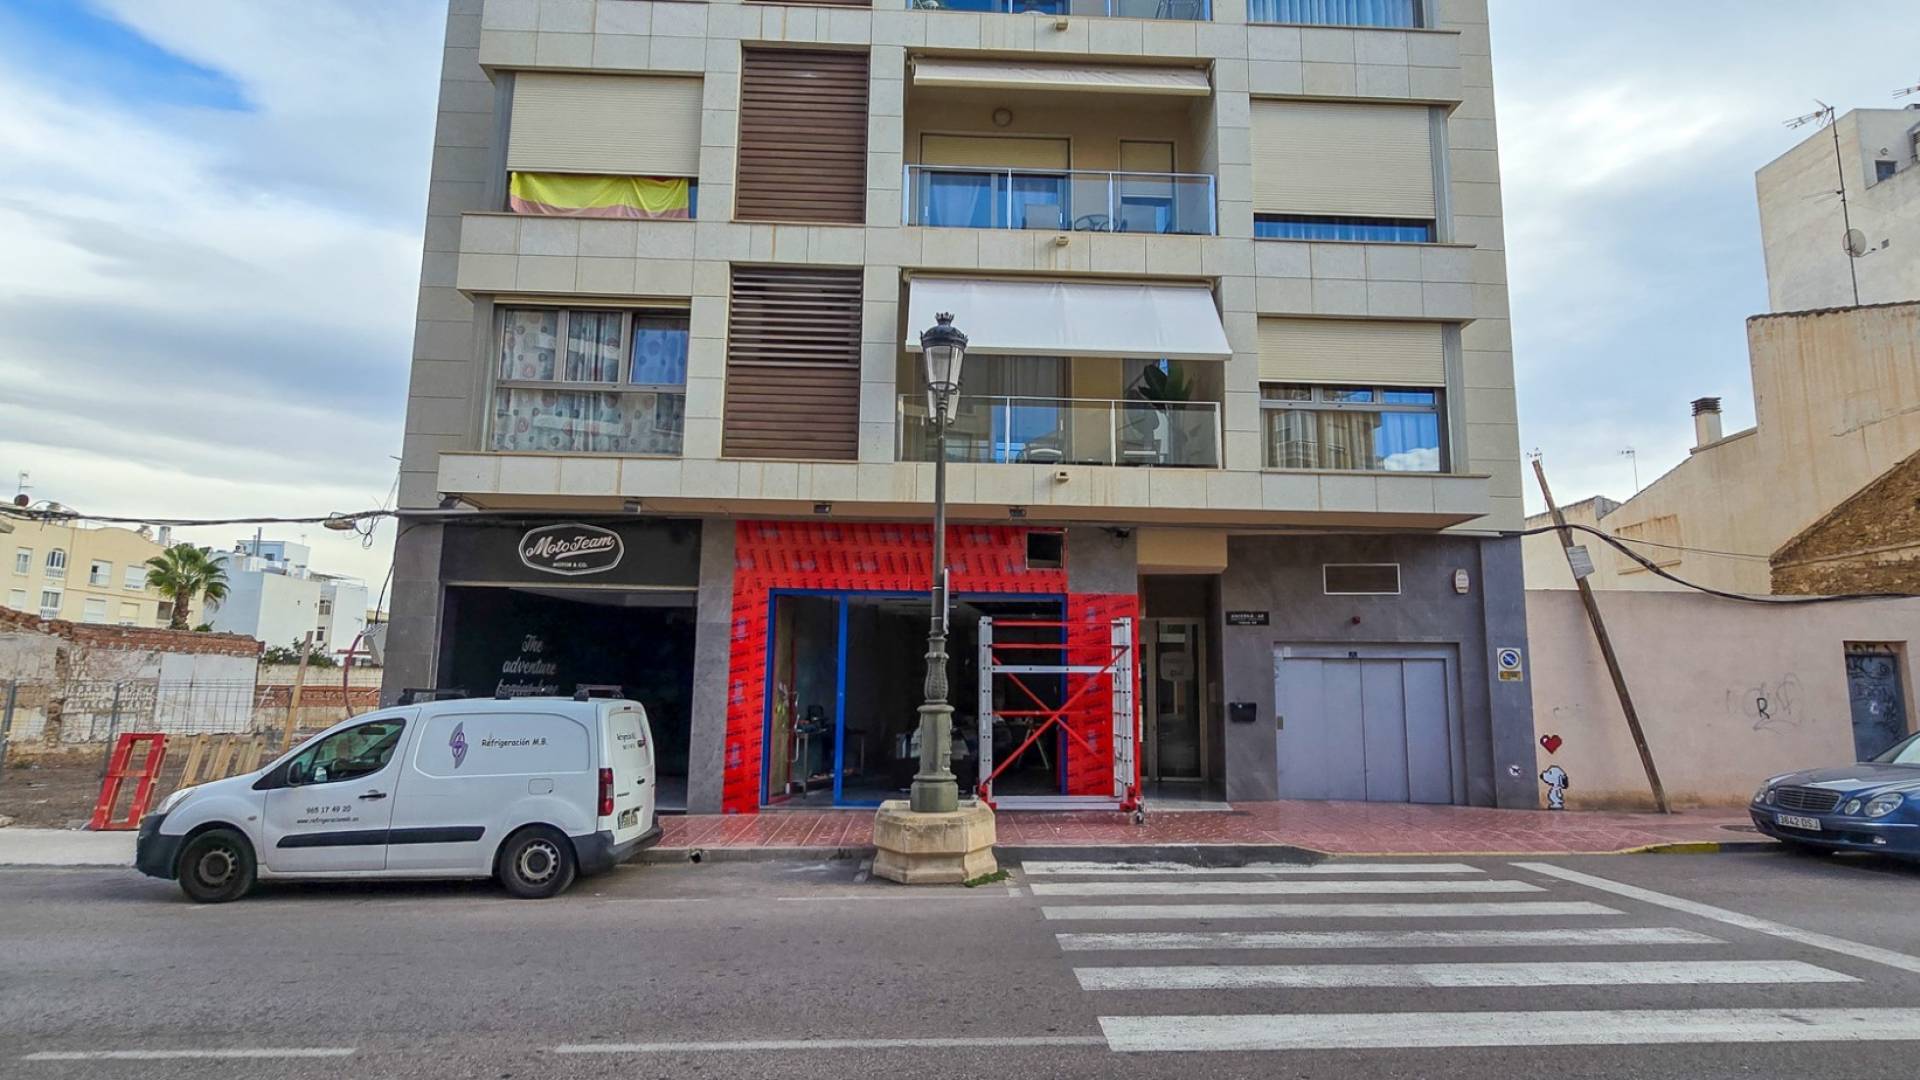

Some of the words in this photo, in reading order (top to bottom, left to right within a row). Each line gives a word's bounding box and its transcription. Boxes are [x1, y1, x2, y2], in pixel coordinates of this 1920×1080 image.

[521, 634, 544, 653] The
[502, 656, 557, 675] adventure
[1756, 697, 1770, 720] R
